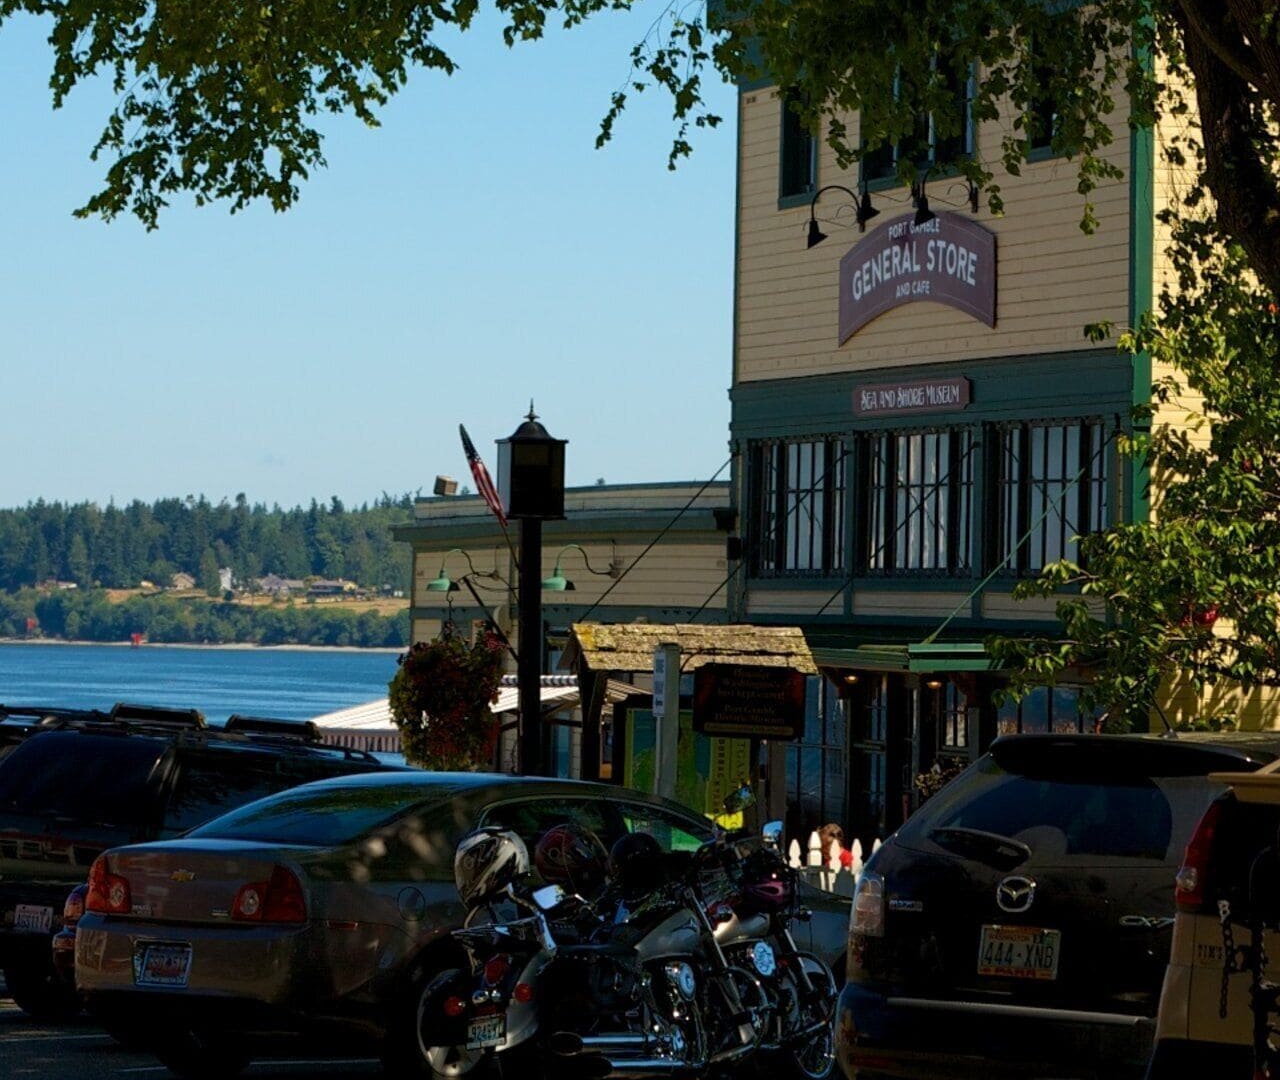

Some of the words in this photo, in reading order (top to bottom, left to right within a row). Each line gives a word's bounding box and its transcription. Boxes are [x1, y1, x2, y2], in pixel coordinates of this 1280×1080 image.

[888, 221, 908, 241] PORT
[852, 242, 921, 301] GENERAL
[926, 239, 978, 287] STORE
[896, 282, 910, 298] AND
[861, 389, 877, 410] SEA
[879, 390, 896, 408] AND
[897, 387, 925, 408] SHORE
[926, 384, 960, 405] MUSEUM
